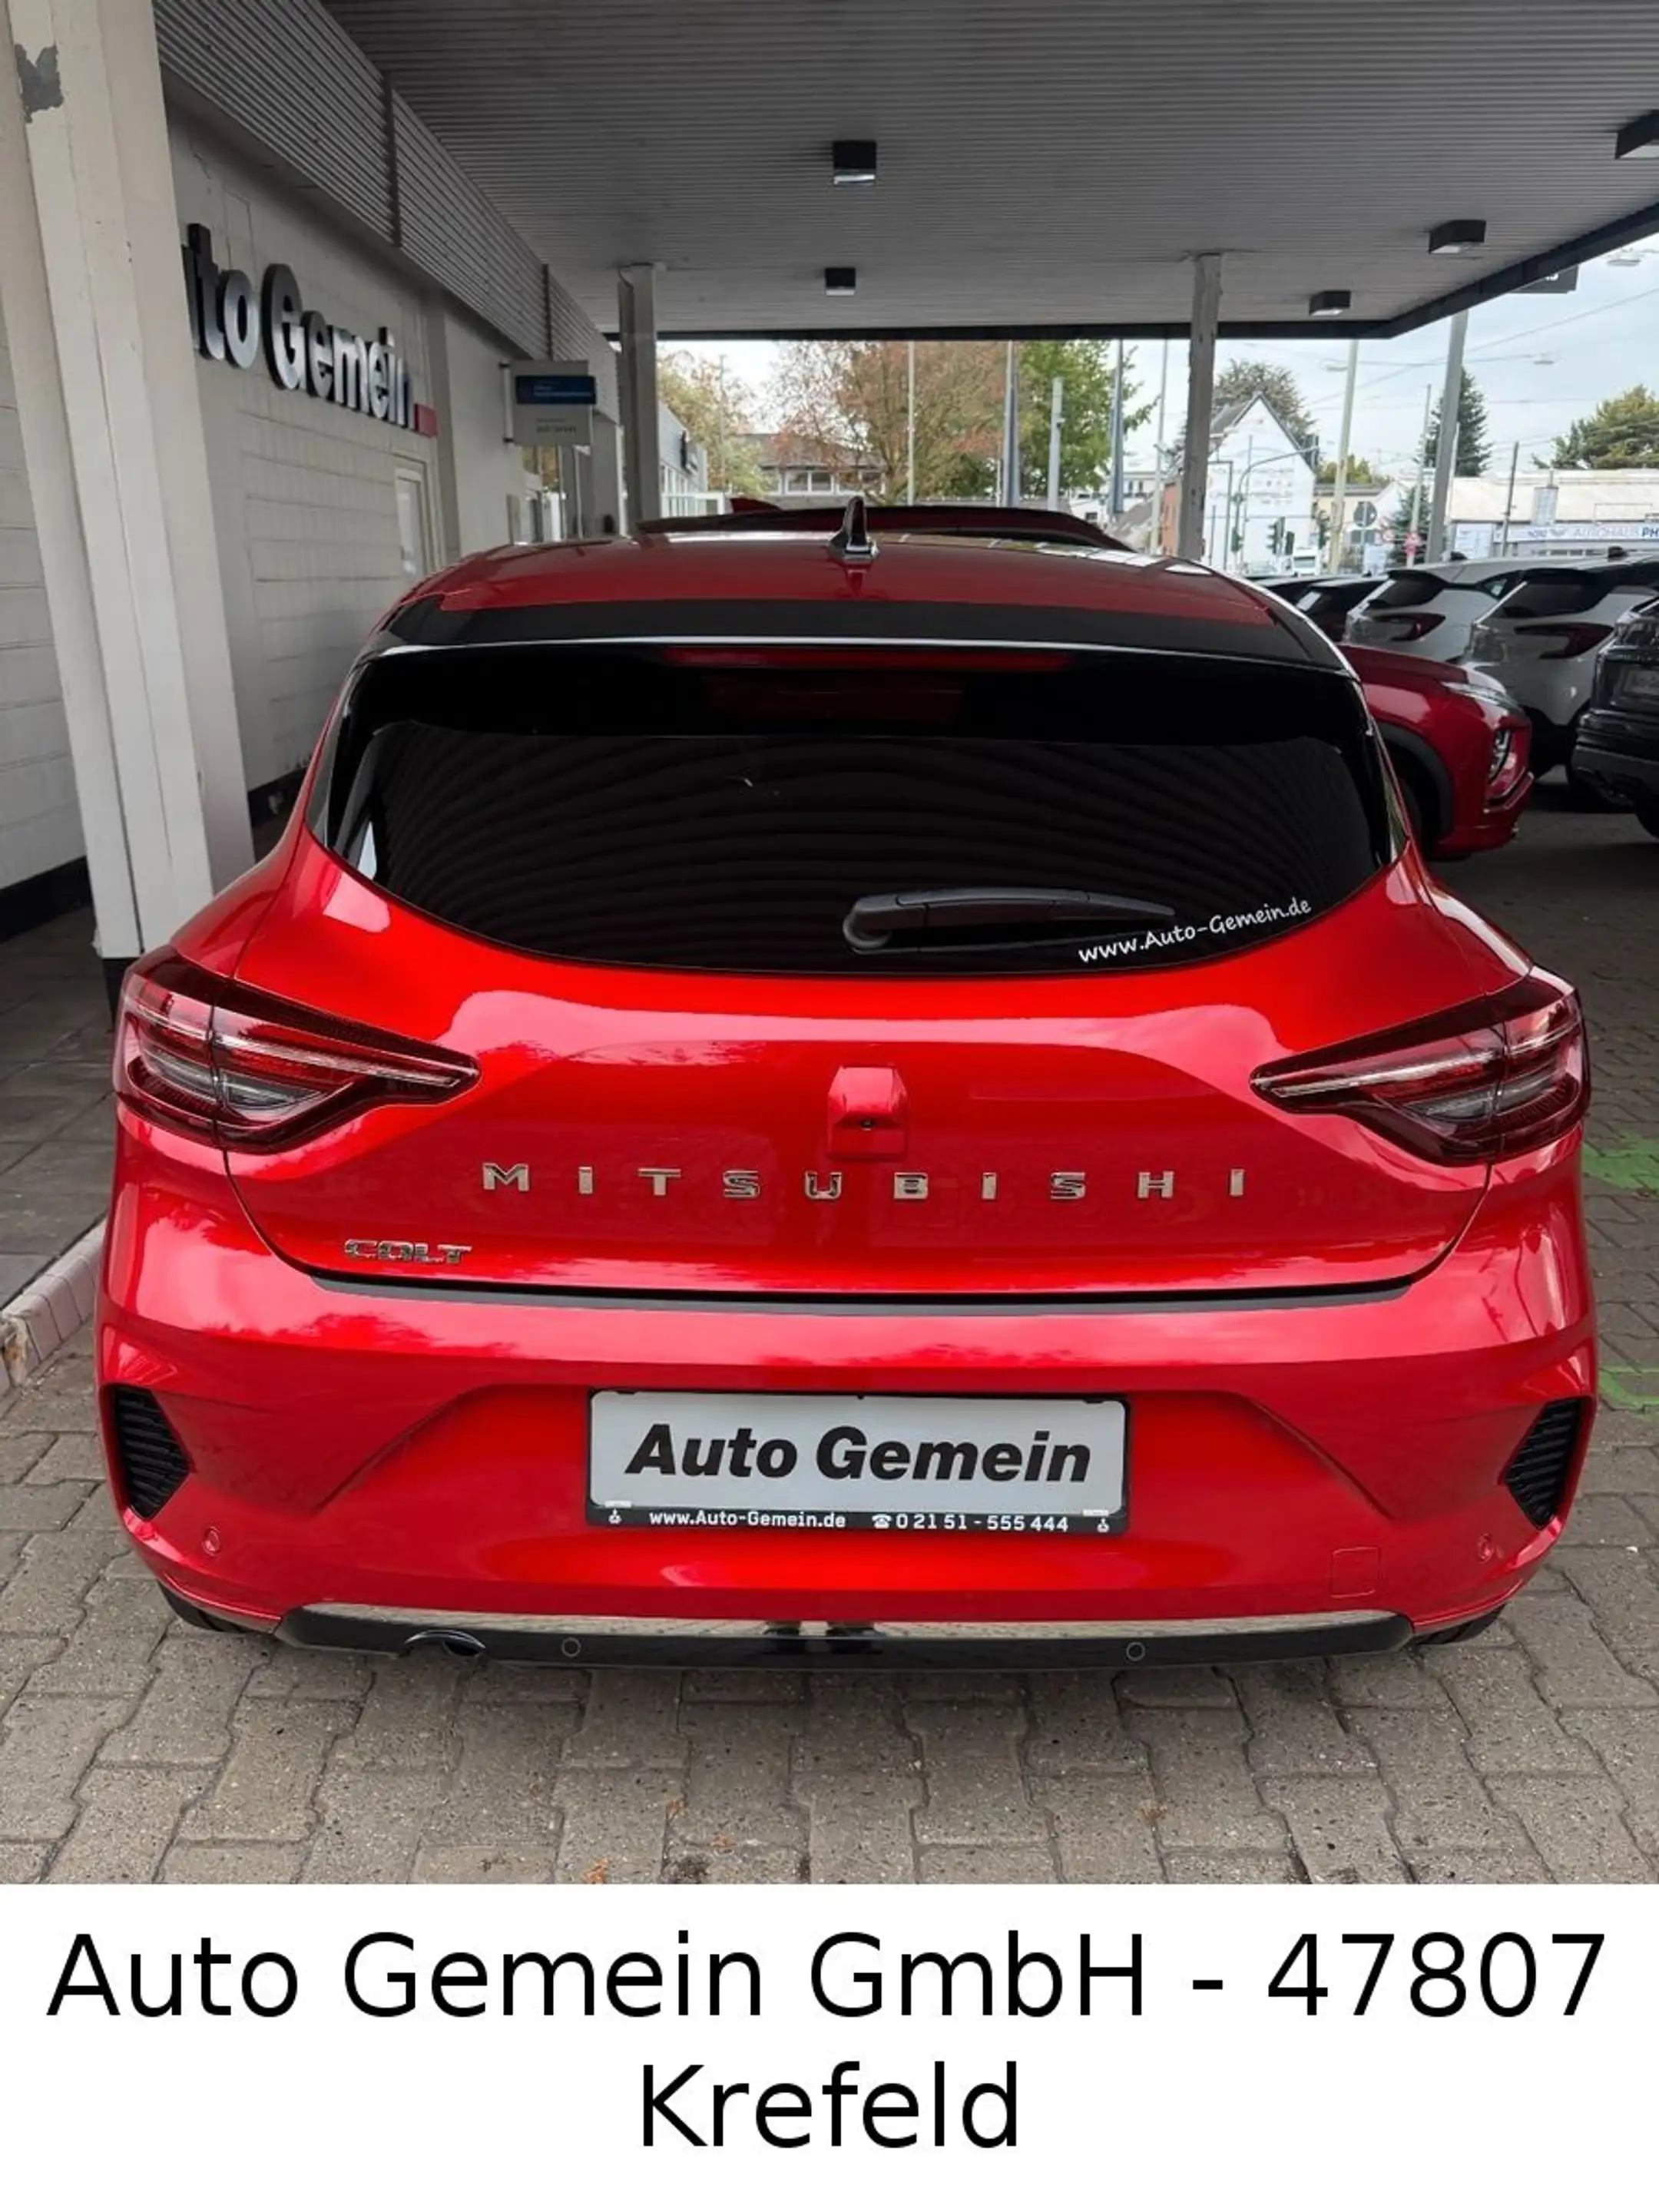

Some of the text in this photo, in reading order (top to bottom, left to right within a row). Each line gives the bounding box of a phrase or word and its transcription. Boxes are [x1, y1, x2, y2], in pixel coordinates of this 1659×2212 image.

[260, 263, 418, 430] Gemein
[1078, 896, 1312, 963] www.Auto-Gemein.de
[482, 1161, 1245, 1200] MITSUBISHI
[344, 1238, 472, 1264] COLT
[624, 1423, 1091, 1482] Auto Gemein
[648, 1509, 846, 1528] www.Auto-Gemein.de
[986, 1515, 1026, 1532] 555
[1030, 1515, 1069, 1532] 444
